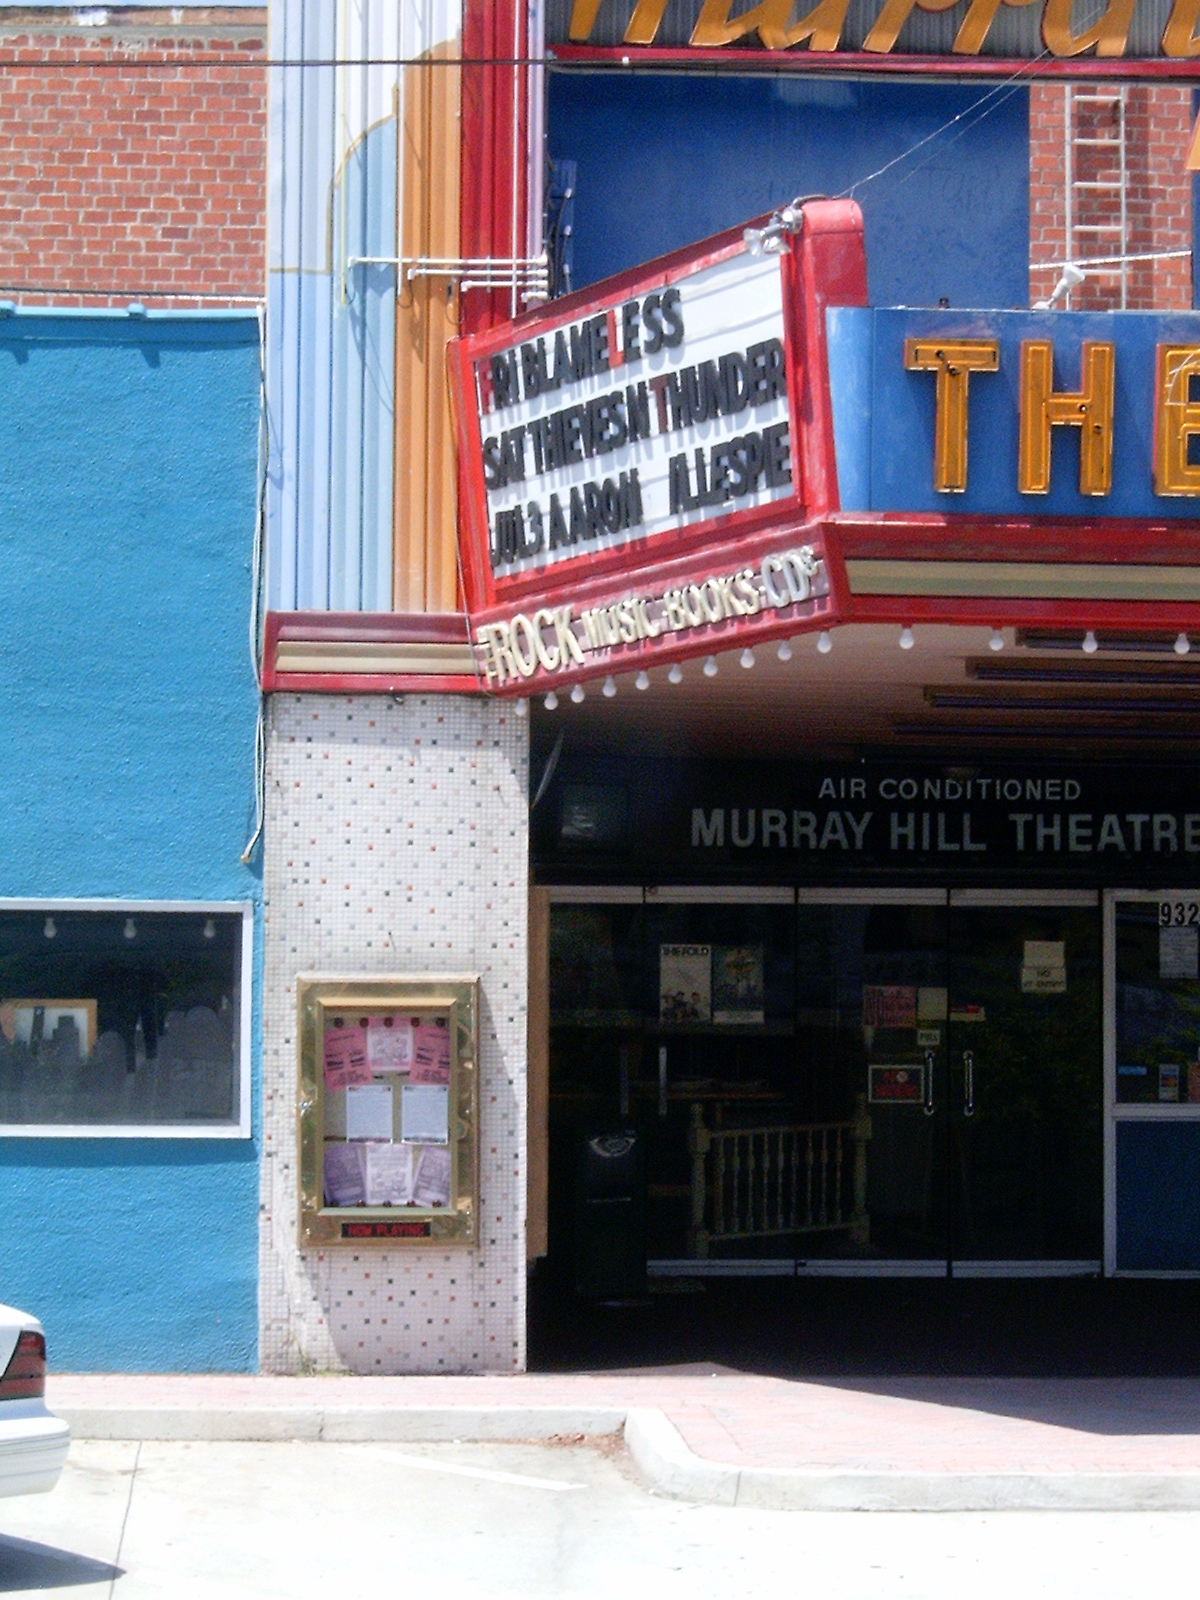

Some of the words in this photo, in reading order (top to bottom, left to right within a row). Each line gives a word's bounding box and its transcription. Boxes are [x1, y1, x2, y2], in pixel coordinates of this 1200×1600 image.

[480, 349, 521, 414] FRI
[520, 287, 685, 402] BLAMELESS
[484, 424, 527, 491] SAT
[648, 337, 789, 435] THUNDER
[549, 468, 644, 551] AARON
[581, 598, 661, 648] MUSIC
[818, 777, 867, 799] AIR
[878, 778, 1082, 800] CONDITIONED
[691, 808, 873, 850] MURRAY
[890, 811, 988, 851] HILL
[1161, 902, 1199, 925] 932
